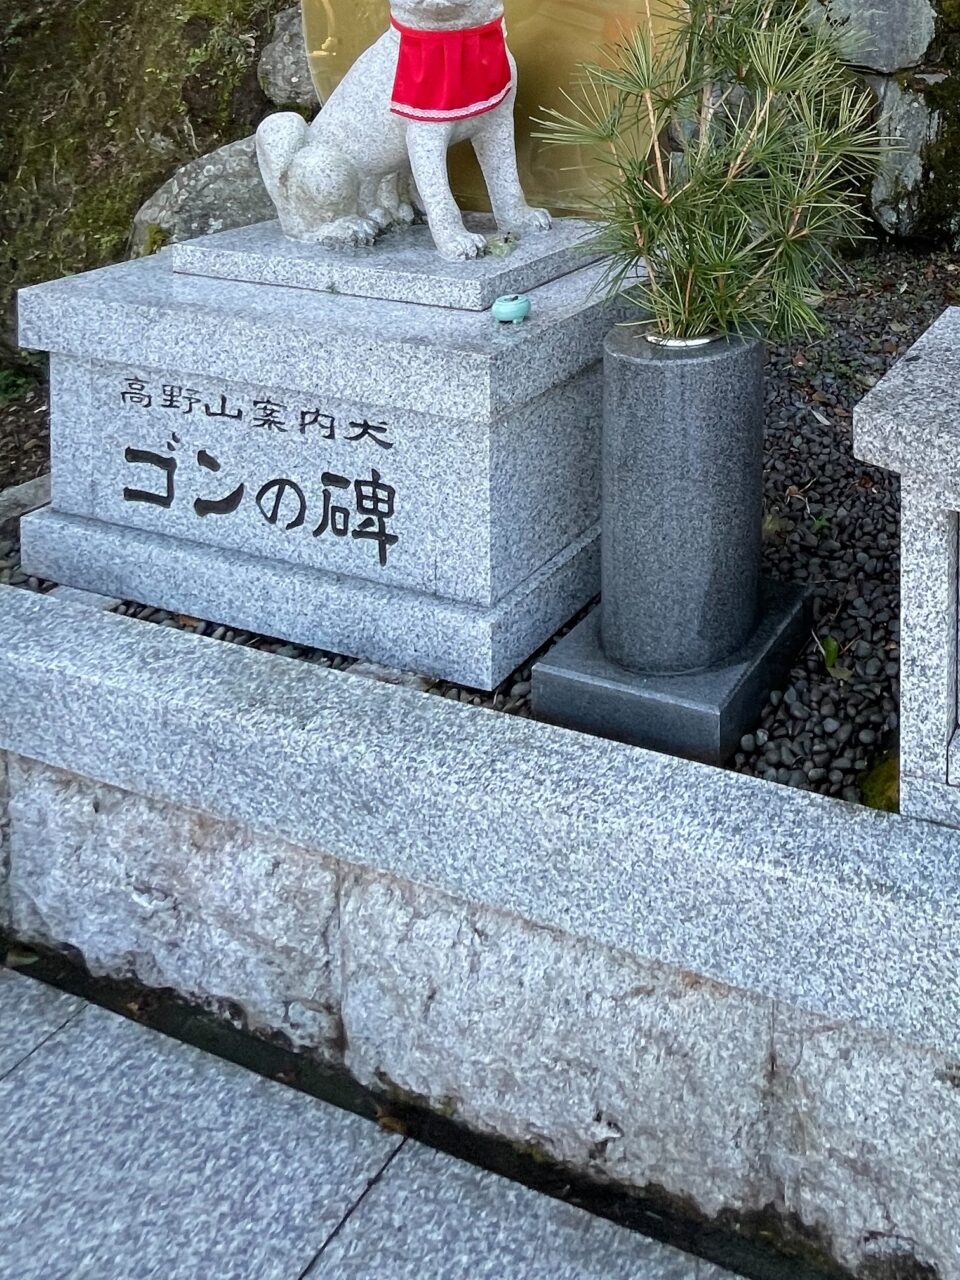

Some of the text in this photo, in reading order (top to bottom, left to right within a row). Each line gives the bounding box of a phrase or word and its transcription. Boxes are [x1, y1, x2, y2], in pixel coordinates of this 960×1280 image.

[121, 376, 393, 449] 高野山案内犬
[123, 431, 399, 566] ゴンの碑
